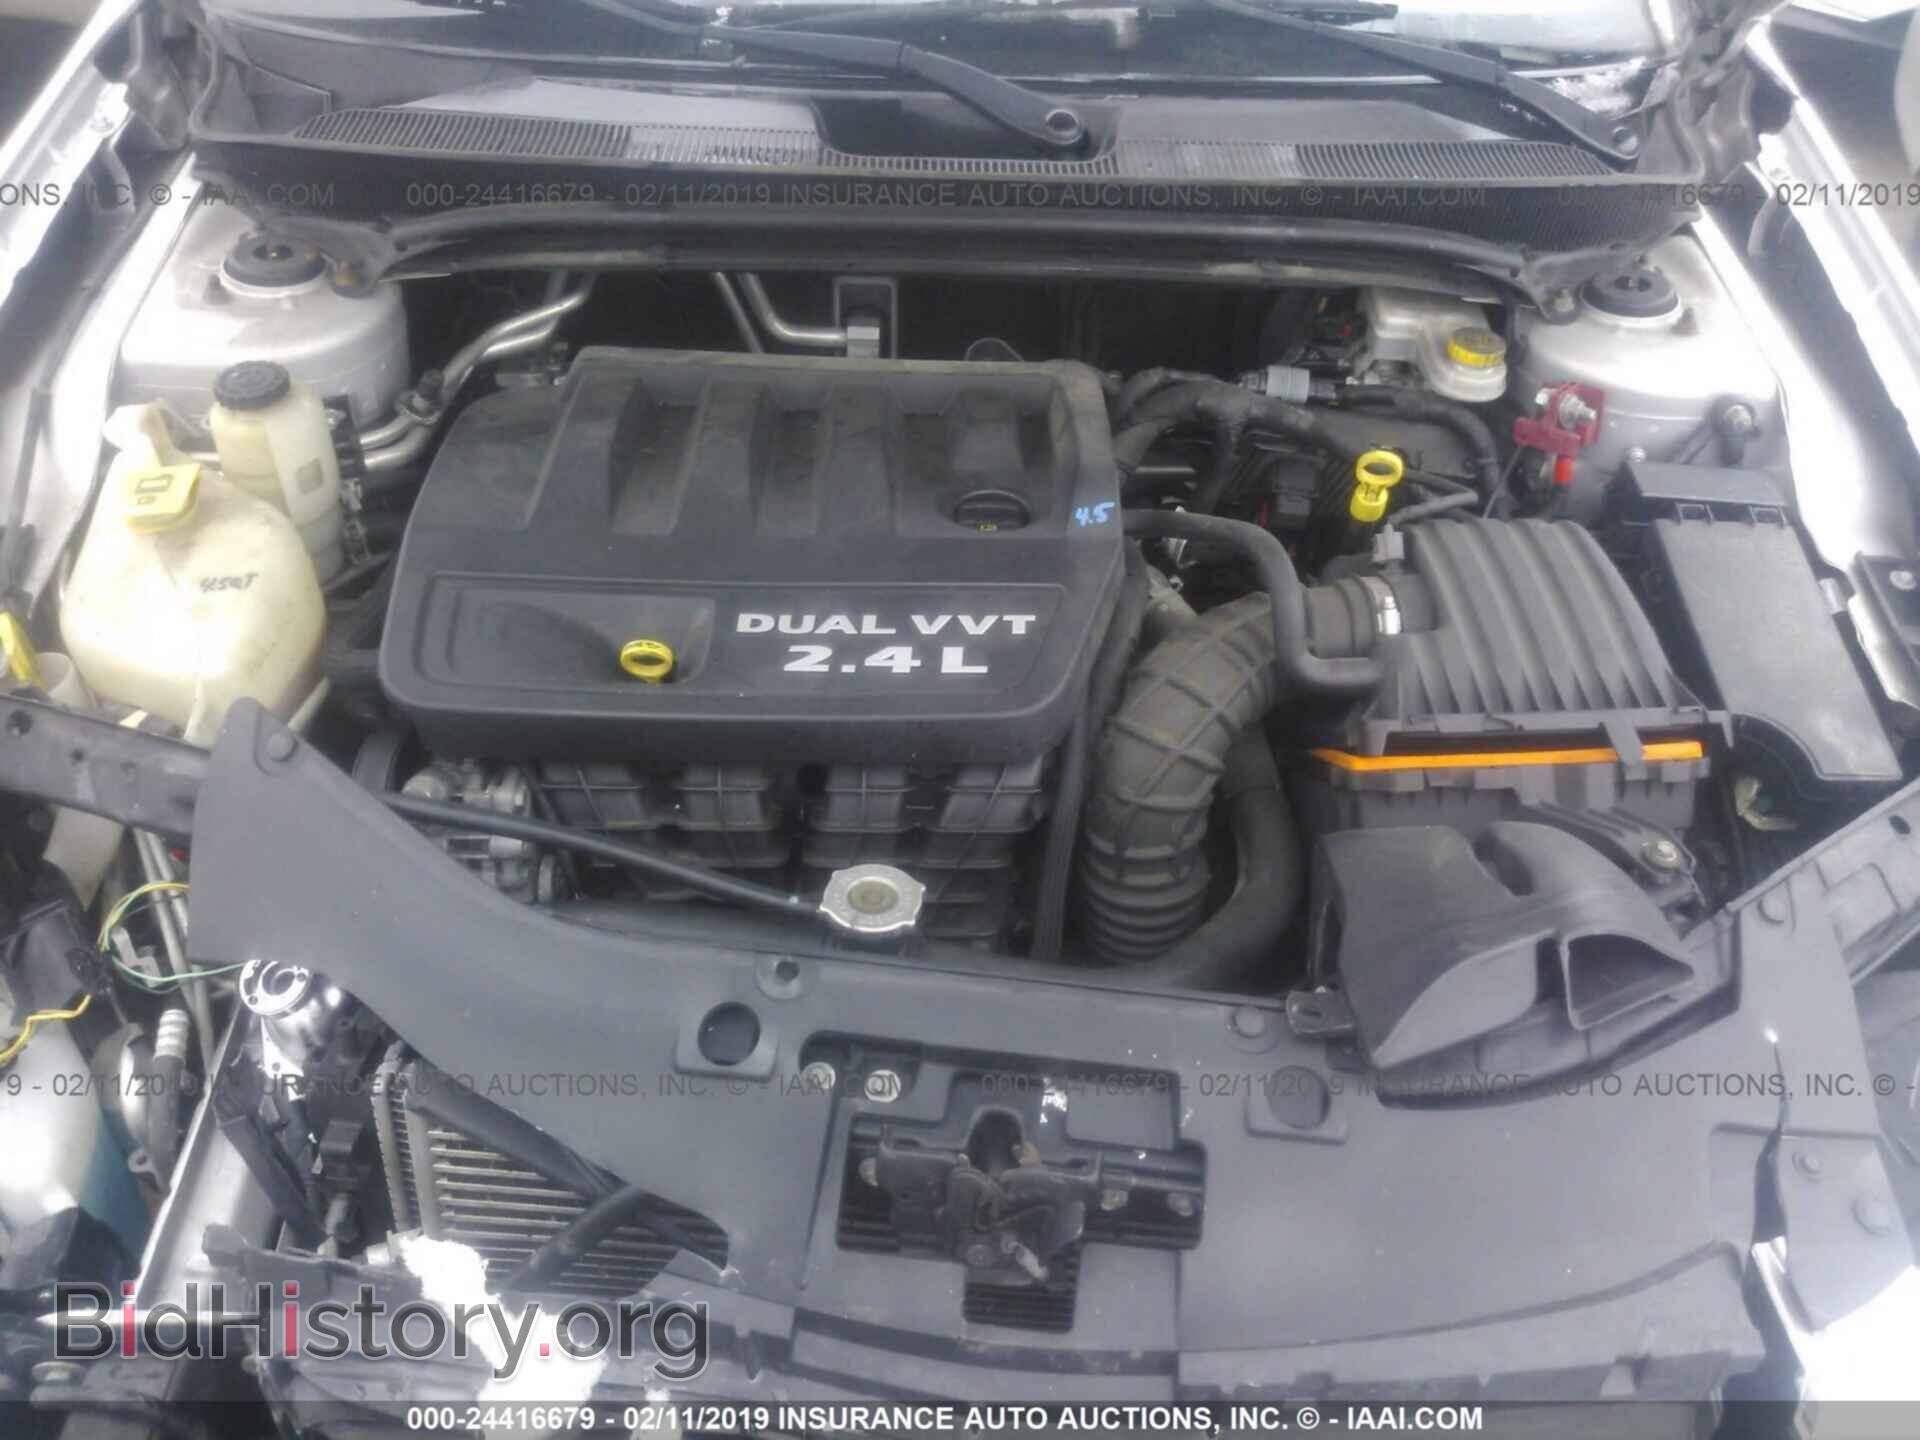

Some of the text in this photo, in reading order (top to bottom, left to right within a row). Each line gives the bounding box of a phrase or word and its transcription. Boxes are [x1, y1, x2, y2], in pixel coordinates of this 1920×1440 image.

[1075, 501, 1115, 527] 4.5
[736, 612, 1036, 635] DUAL VVT
[783, 644, 922, 673] 2.4
